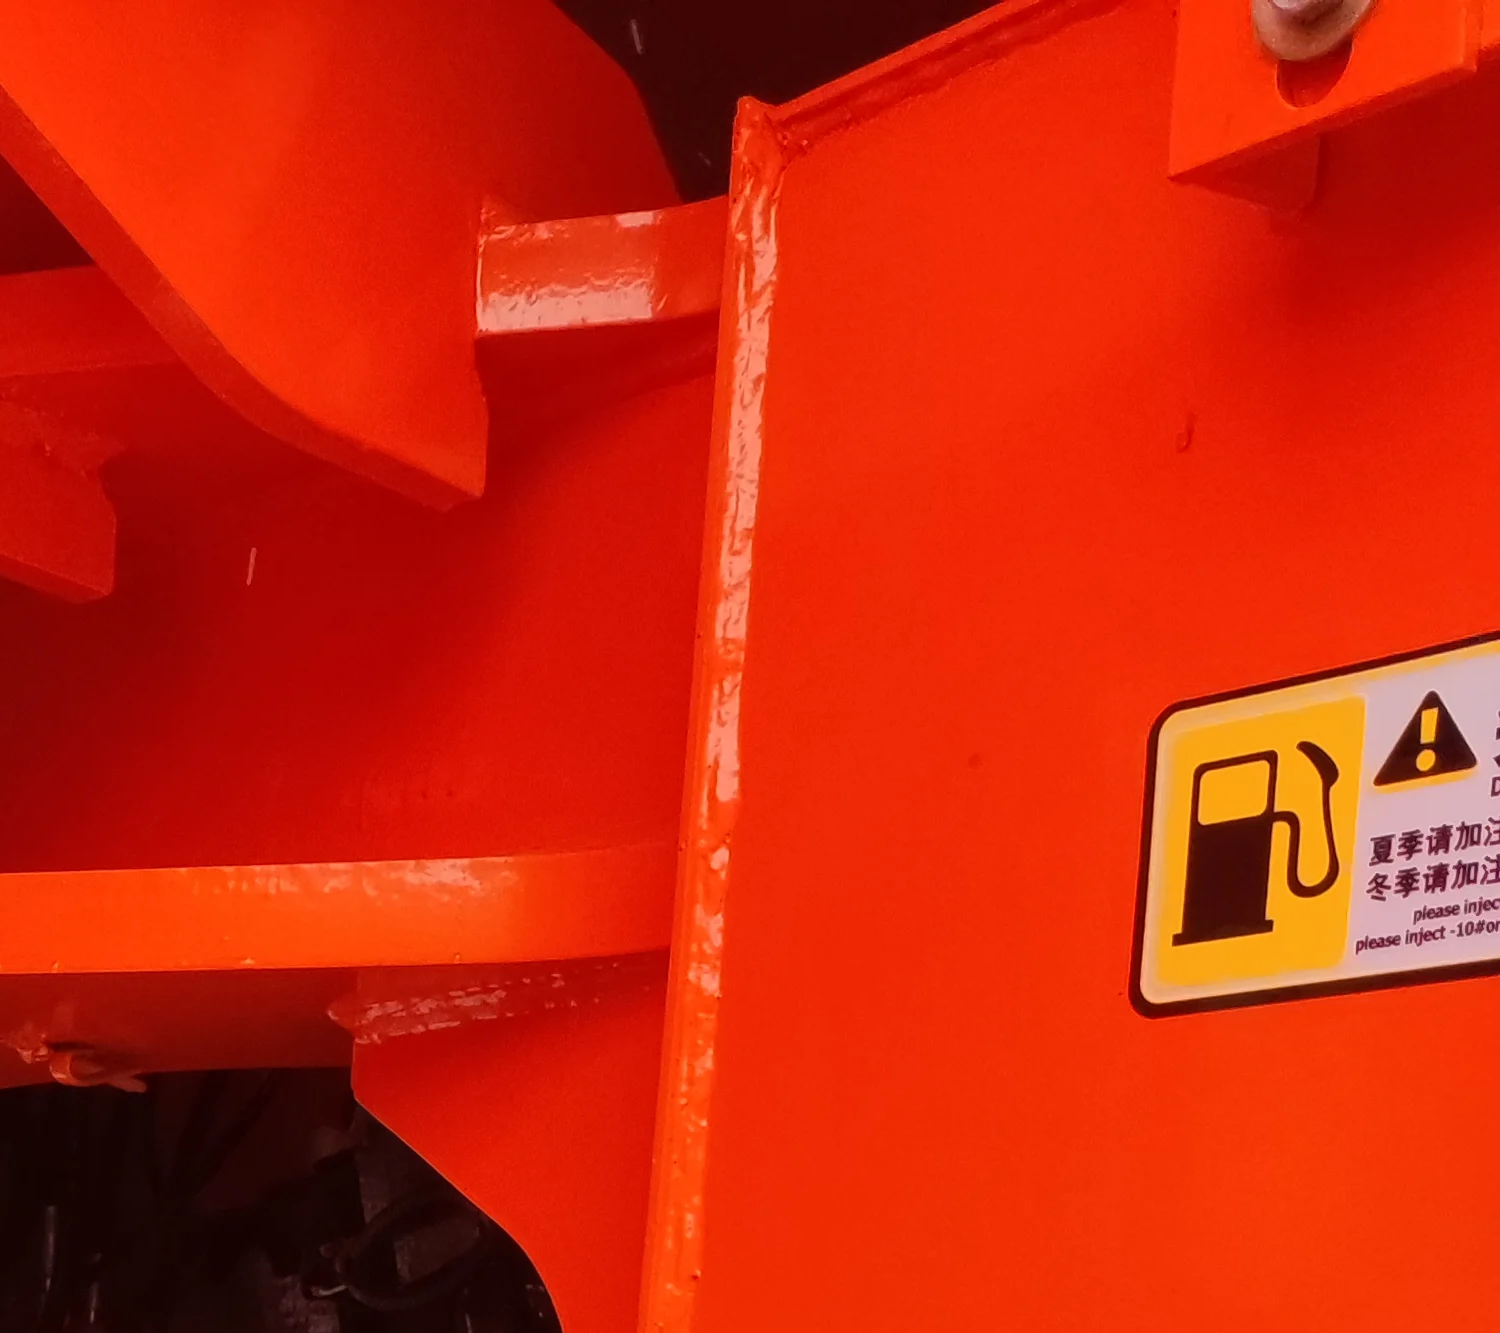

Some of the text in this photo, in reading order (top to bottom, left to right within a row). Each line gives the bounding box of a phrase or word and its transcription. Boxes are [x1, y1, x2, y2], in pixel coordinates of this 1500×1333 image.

[1366, 853, 1500, 902] 冬季请加注
[1412, 904, 1461, 926] please
[1355, 934, 1402, 956] please
[1404, 925, 1446, 947] inject
